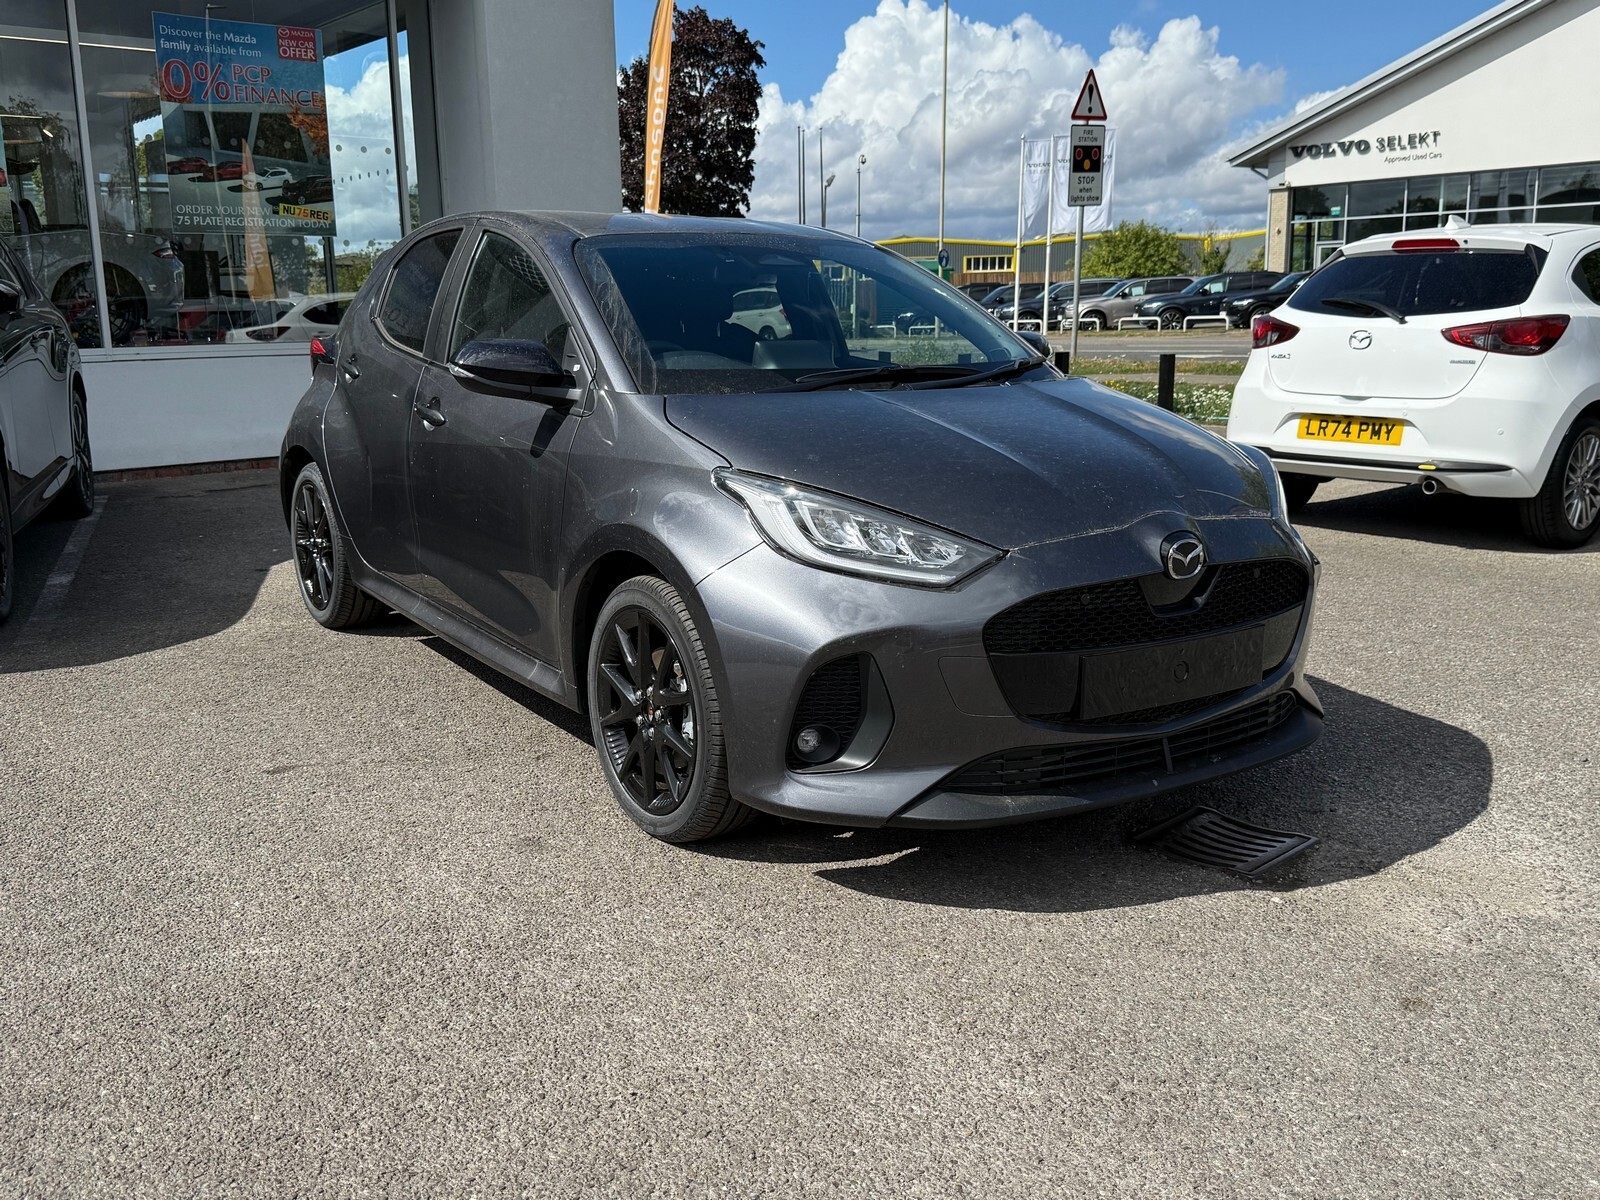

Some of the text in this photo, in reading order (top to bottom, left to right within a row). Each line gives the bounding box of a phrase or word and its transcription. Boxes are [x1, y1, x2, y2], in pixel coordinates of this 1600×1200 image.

[159, 25, 257, 45] Discover the Mazda
[291, 30, 314, 38] MAZDA
[160, 39, 262, 58] family available from
[279, 38, 315, 49] NEW CAR
[280, 47, 316, 60] OFFER
[162, 59, 232, 101] 0%
[231, 63, 272, 83] PCP
[234, 85, 321, 108] FINANCE
[1289, 130, 1441, 159] VOLVO SELEKT
[1384, 151, 1442, 164] Approved Used Cars
[1077, 176, 1095, 184] STOP
[1071, 195, 1085, 203] lights
[176, 205, 270, 216] ORDER YOUR NEW
[177, 215, 331, 229] 75 PLATE REGISTRATION TODAY
[1306, 419, 1396, 441] LR74 PMY
